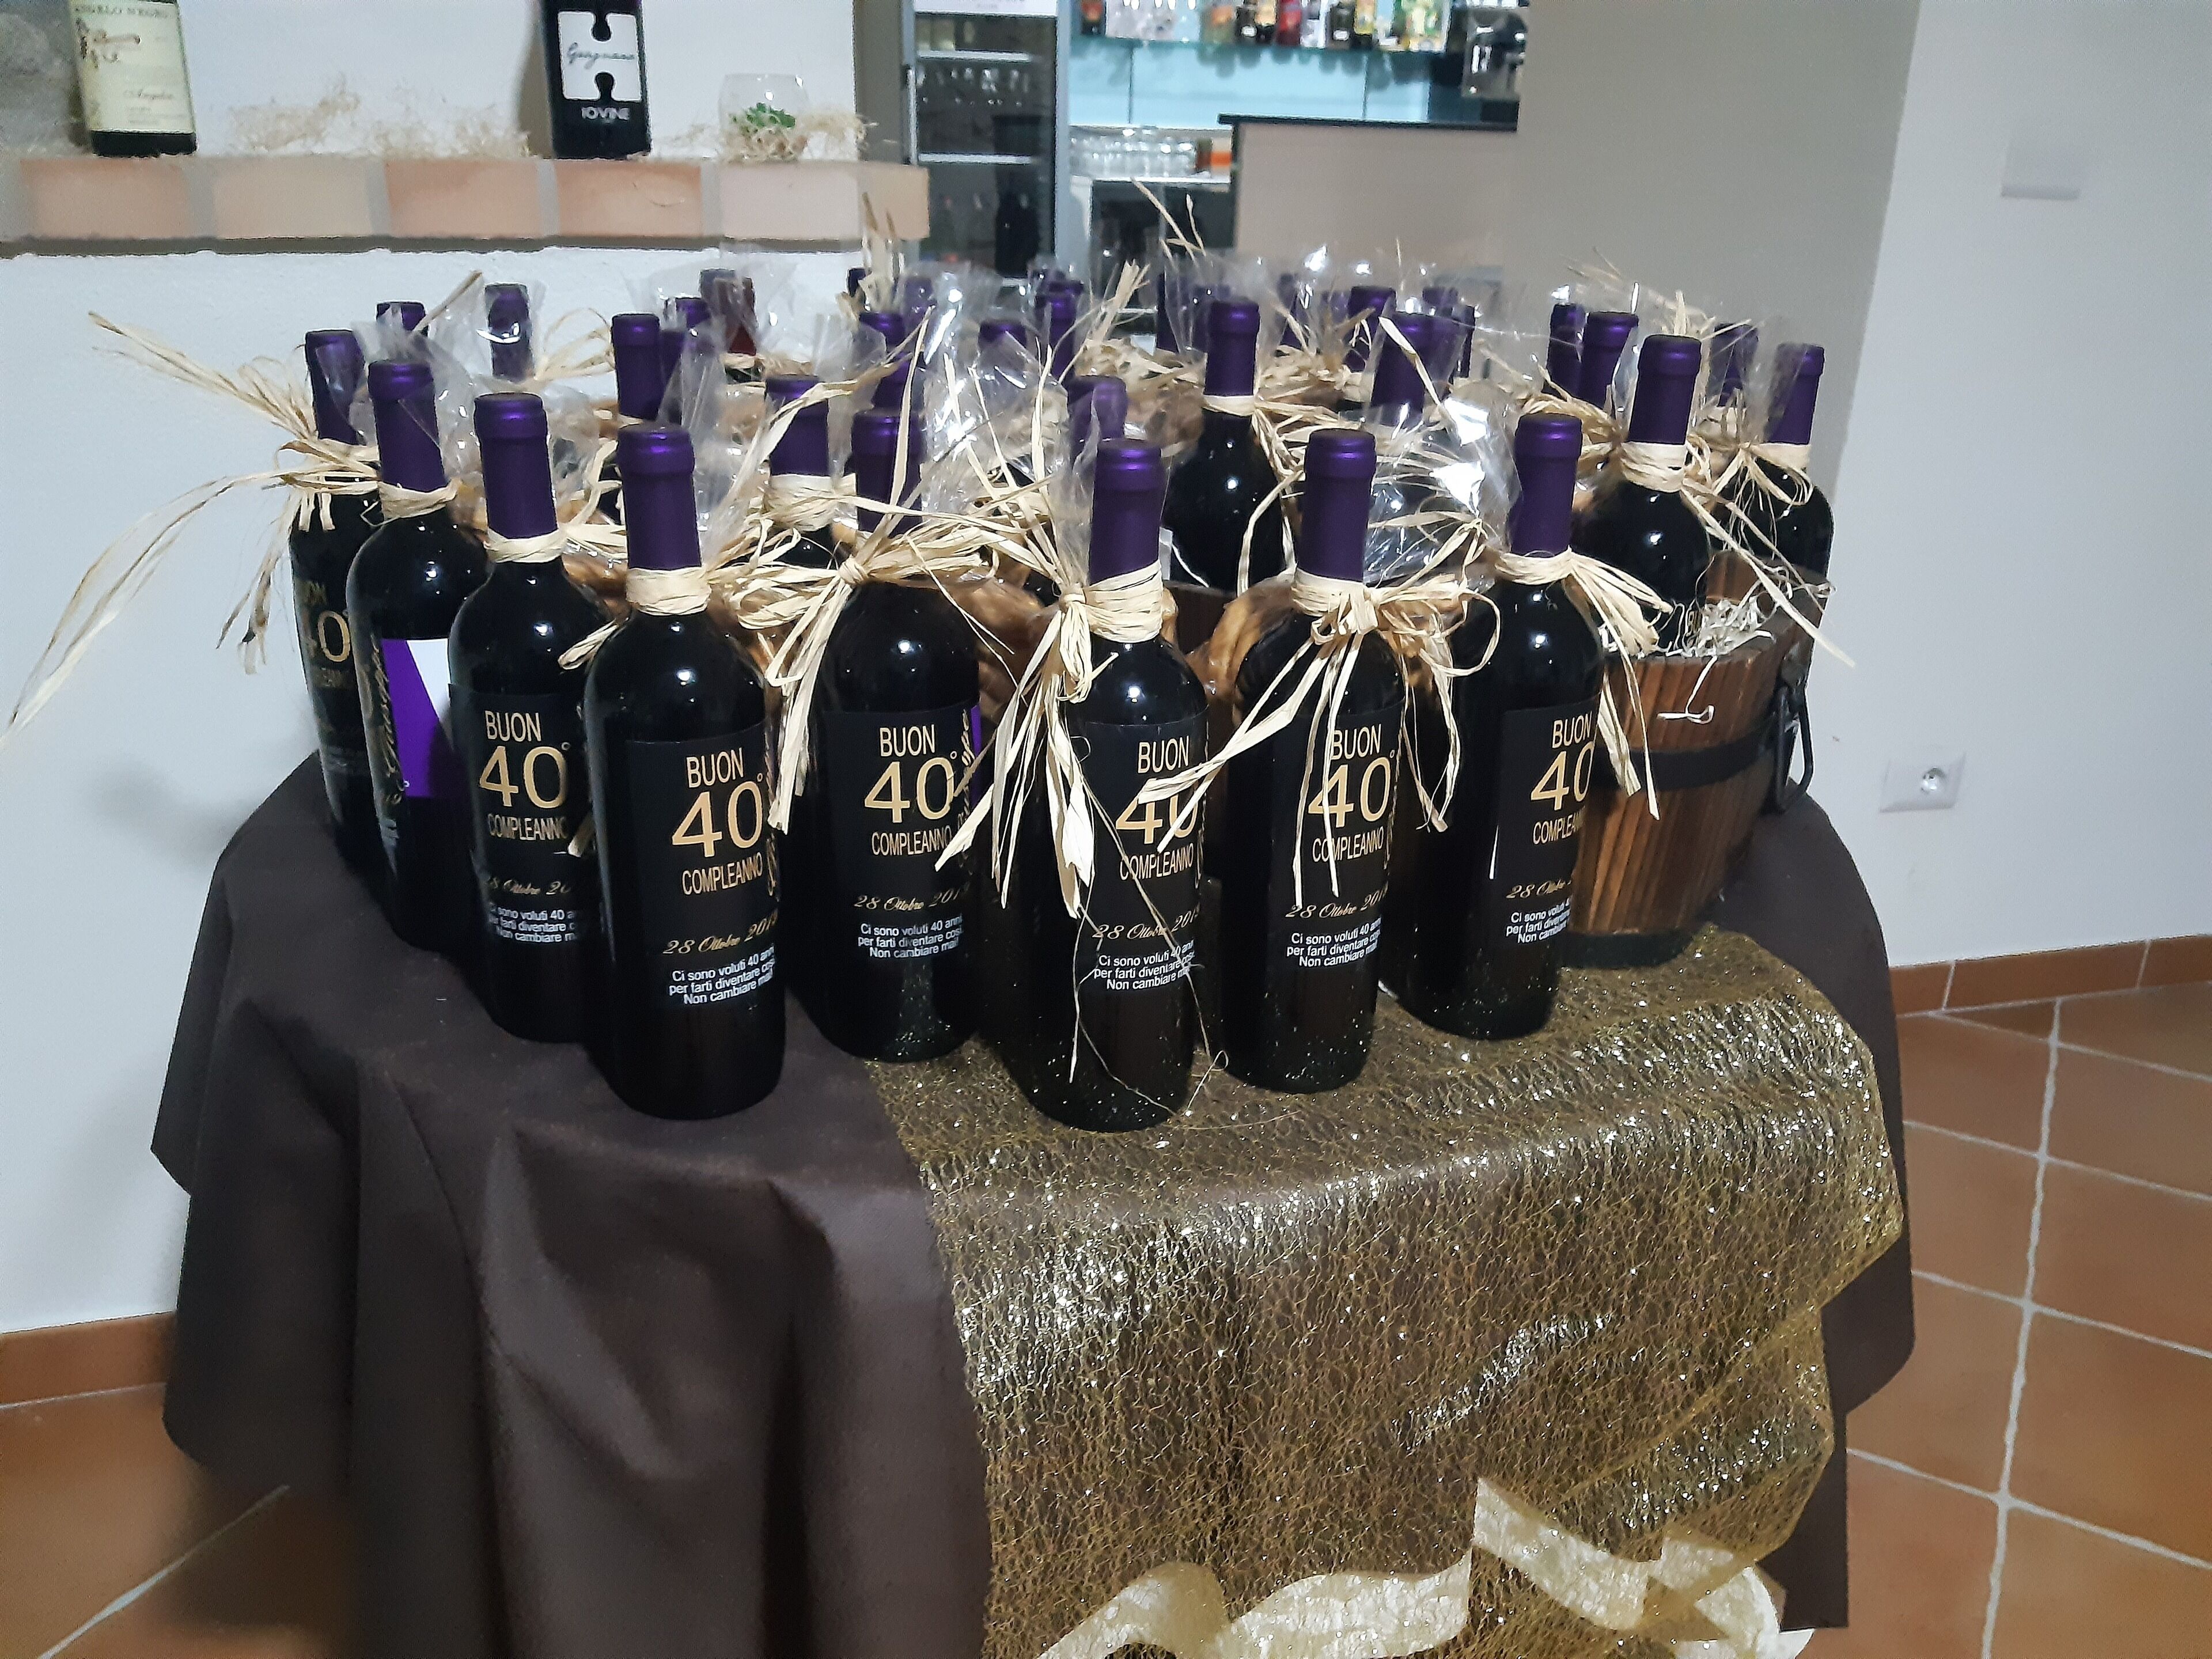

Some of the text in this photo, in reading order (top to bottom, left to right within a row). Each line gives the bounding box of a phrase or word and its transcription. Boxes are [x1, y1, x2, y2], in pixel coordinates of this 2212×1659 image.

[484, 710, 541, 742] BUON
[1552, 711, 1592, 748] BUON
[880, 724, 935, 757] BUON
[1331, 724, 1381, 760] BUON
[1138, 736, 1189, 774] BUON
[686, 747, 744, 788] BUON
[872, 825, 952, 856] COMPLEANNO
[1312, 826, 1384, 862] COMPLEANNO
[1120, 843, 1194, 881] COMPLEANNO
[682, 852, 763, 895] COMPLEANNO
[1506, 885, 1535, 899] 28
[854, 896, 880, 910] 28
[1285, 904, 1316, 918] 28
[550, 910, 565, 920] 40
[1511, 912, 1522, 923] Ci
[1524, 911, 1547, 922] sono
[518, 921, 566, 932] diventare
[861, 923, 871, 934] Ci
[873, 926, 899, 936] sono
[902, 925, 928, 935] voluti
[930, 921, 943, 931] 40
[1092, 925, 1124, 939] 28
[1291, 933, 1303, 944] Ci
[1306, 935, 1332, 945] sono
[1334, 927, 1358, 942] voluti
[1359, 923, 1369, 935] 40
[1506, 925, 1522, 937] per
[1525, 922, 1543, 933] farti
[514, 931, 562, 942] cambiare
[858, 937, 874, 947] per
[876, 937, 896, 948] farti
[899, 933, 944, 948] diventare
[1518, 933, 1537, 944] Non
[662, 940, 695, 955] 28
[870, 948, 891, 958] Non
[893, 945, 939, 958] cambiare
[1287, 946, 1305, 957] per
[1307, 945, 1327, 957] farti
[1330, 936, 1369, 955] diventare
[1099, 955, 1111, 967] Ci
[1113, 957, 1141, 967] sono
[1143, 949, 1169, 965] voluti
[1299, 956, 1321, 967] Non
[1323, 949, 1365, 966] cambiare
[672, 970, 684, 982] Ci
[687, 969, 716, 980] sono
[718, 959, 746, 976] voluti
[748, 953, 759, 967] 40
[1094, 968, 1113, 979] per
[1115, 968, 1136, 979] farti
[1138, 960, 1181, 978] diventare
[669, 985, 688, 996] per
[691, 980, 712, 994] farti
[715, 967, 760, 990] diventare
[1107, 979, 1130, 990] Non
[1132, 972, 1177, 989] cambiare
[683, 994, 707, 1005] Non
[710, 980, 757, 1002] cambiare
